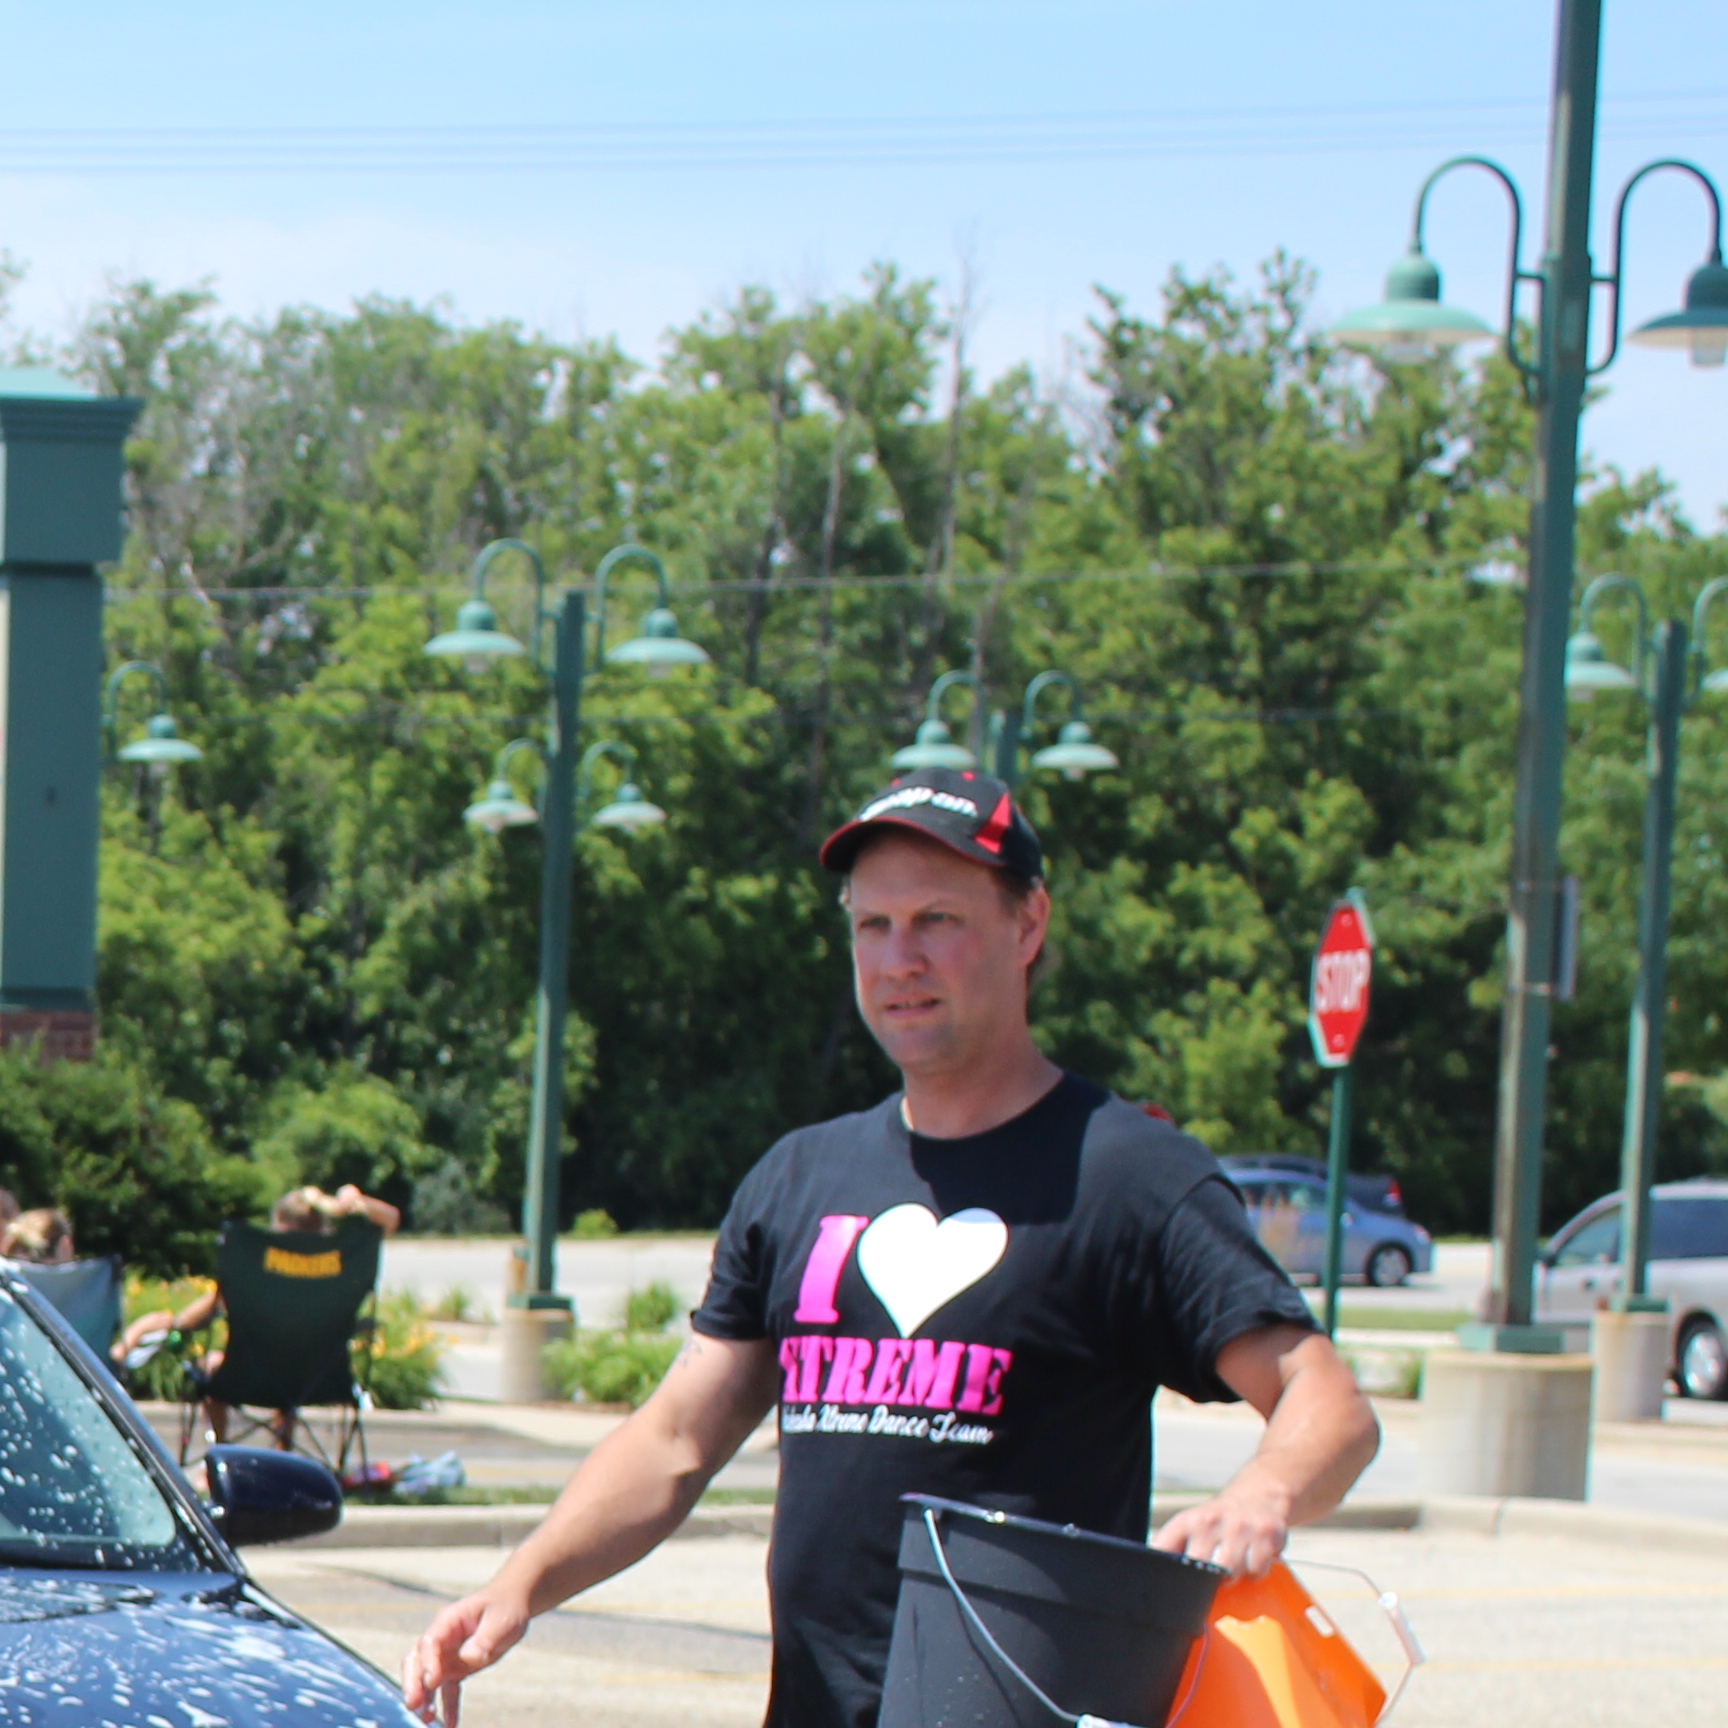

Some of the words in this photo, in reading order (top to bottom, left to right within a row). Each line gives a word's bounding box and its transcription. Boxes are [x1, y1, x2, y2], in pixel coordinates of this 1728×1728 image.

[1316, 950, 1371, 1013] STOP
[794, 1215, 869, 1323] I
[867, 1403, 929, 1438] Dance
[928, 1410, 995, 1445] Team
